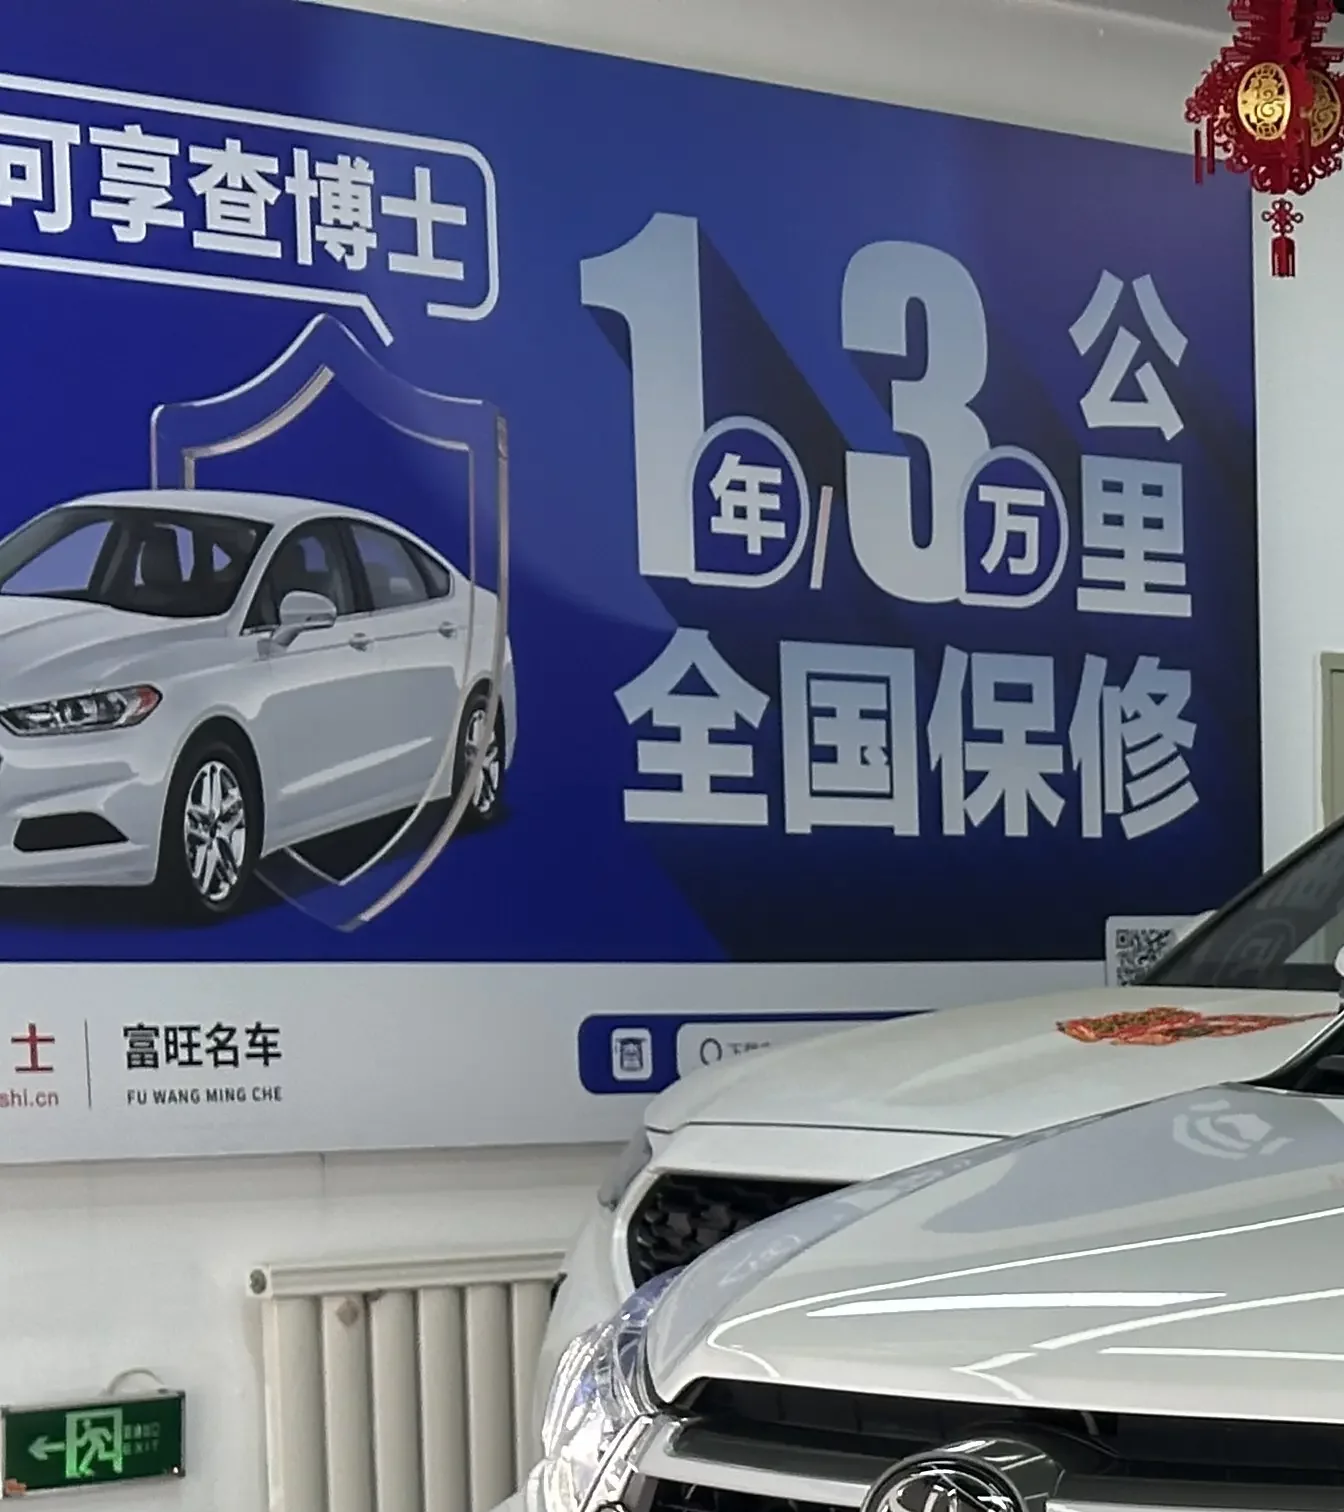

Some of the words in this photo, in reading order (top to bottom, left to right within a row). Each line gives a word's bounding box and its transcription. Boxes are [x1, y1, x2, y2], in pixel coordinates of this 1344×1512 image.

[0, 113, 467, 281] 可享查博士
[614, 626, 1199, 840] 全国保修
[123, 1021, 282, 1069] 富旺名车
[127, 1089, 147, 1105] FU
[153, 1088, 200, 1104] WANG
[206, 1087, 246, 1103] MING
[252, 1086, 282, 1102] CHE
